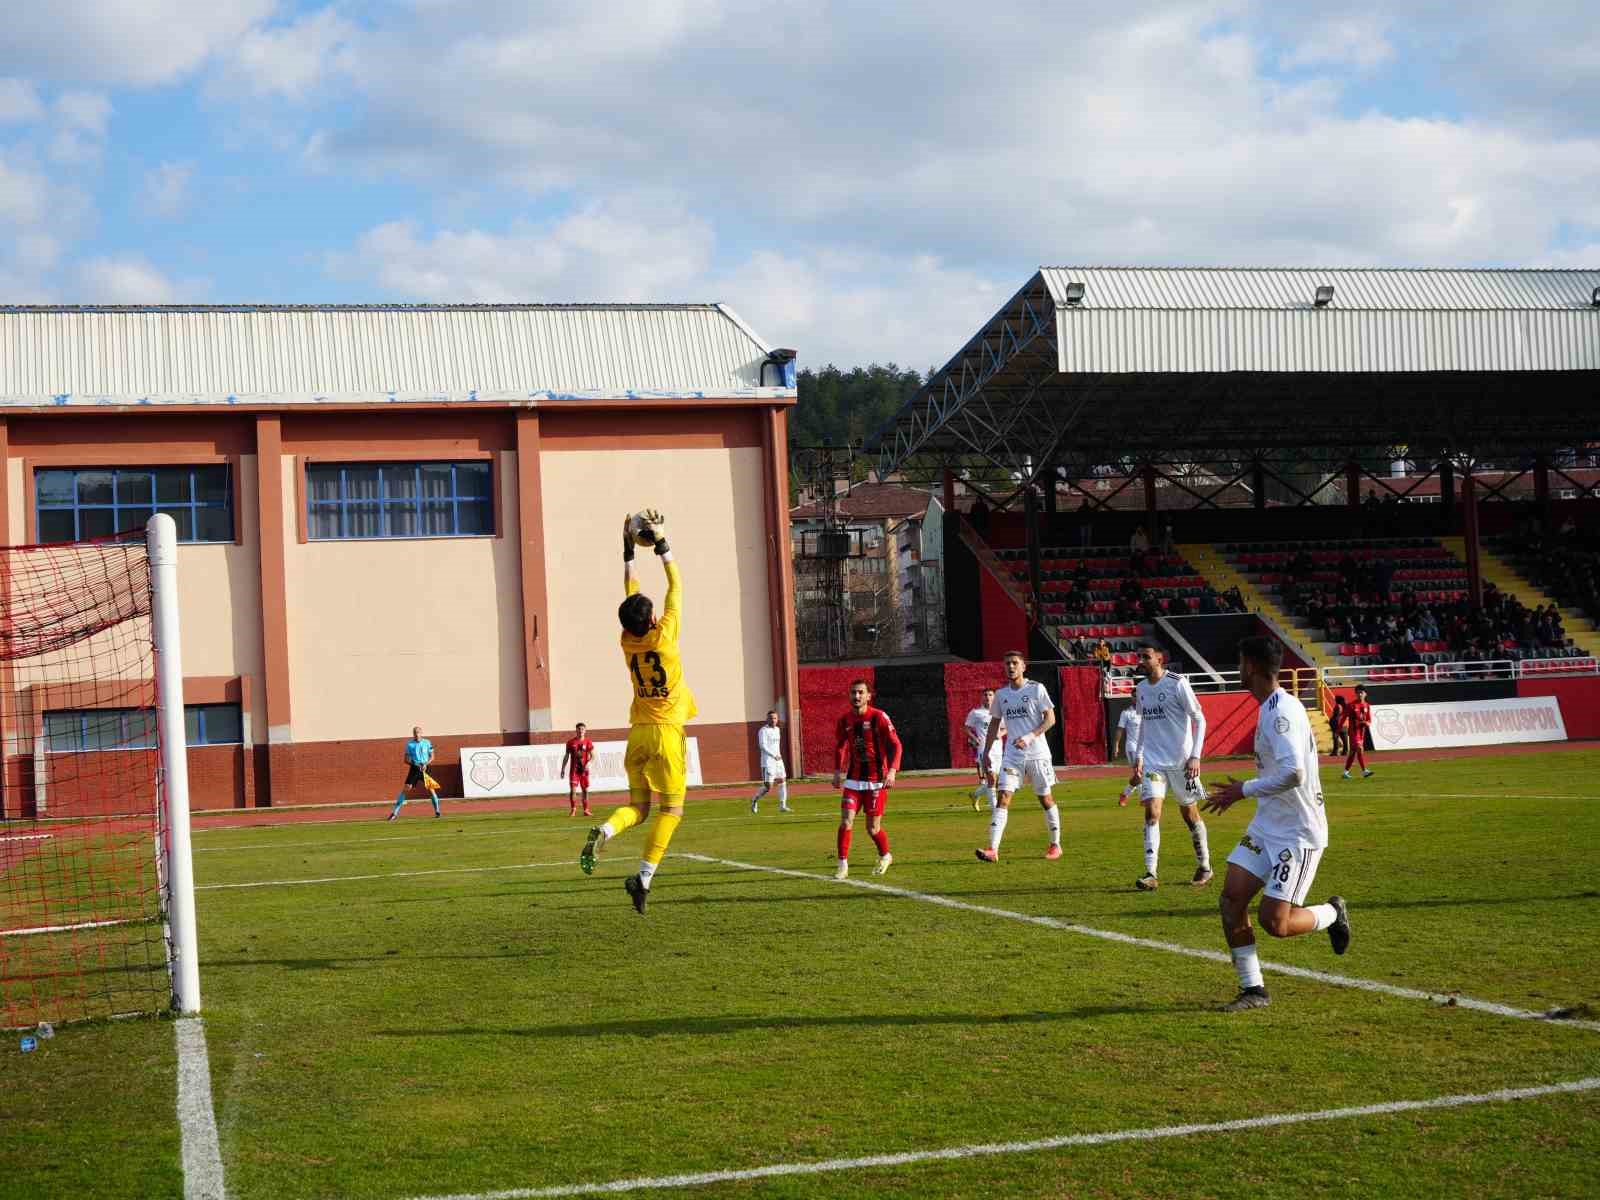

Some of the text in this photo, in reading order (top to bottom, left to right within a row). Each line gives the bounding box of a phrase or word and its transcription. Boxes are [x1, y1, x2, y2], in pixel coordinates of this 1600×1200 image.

[631, 651, 667, 688] 13
[1185, 781, 1197, 792] 44
[1272, 863, 1290, 883] 18
